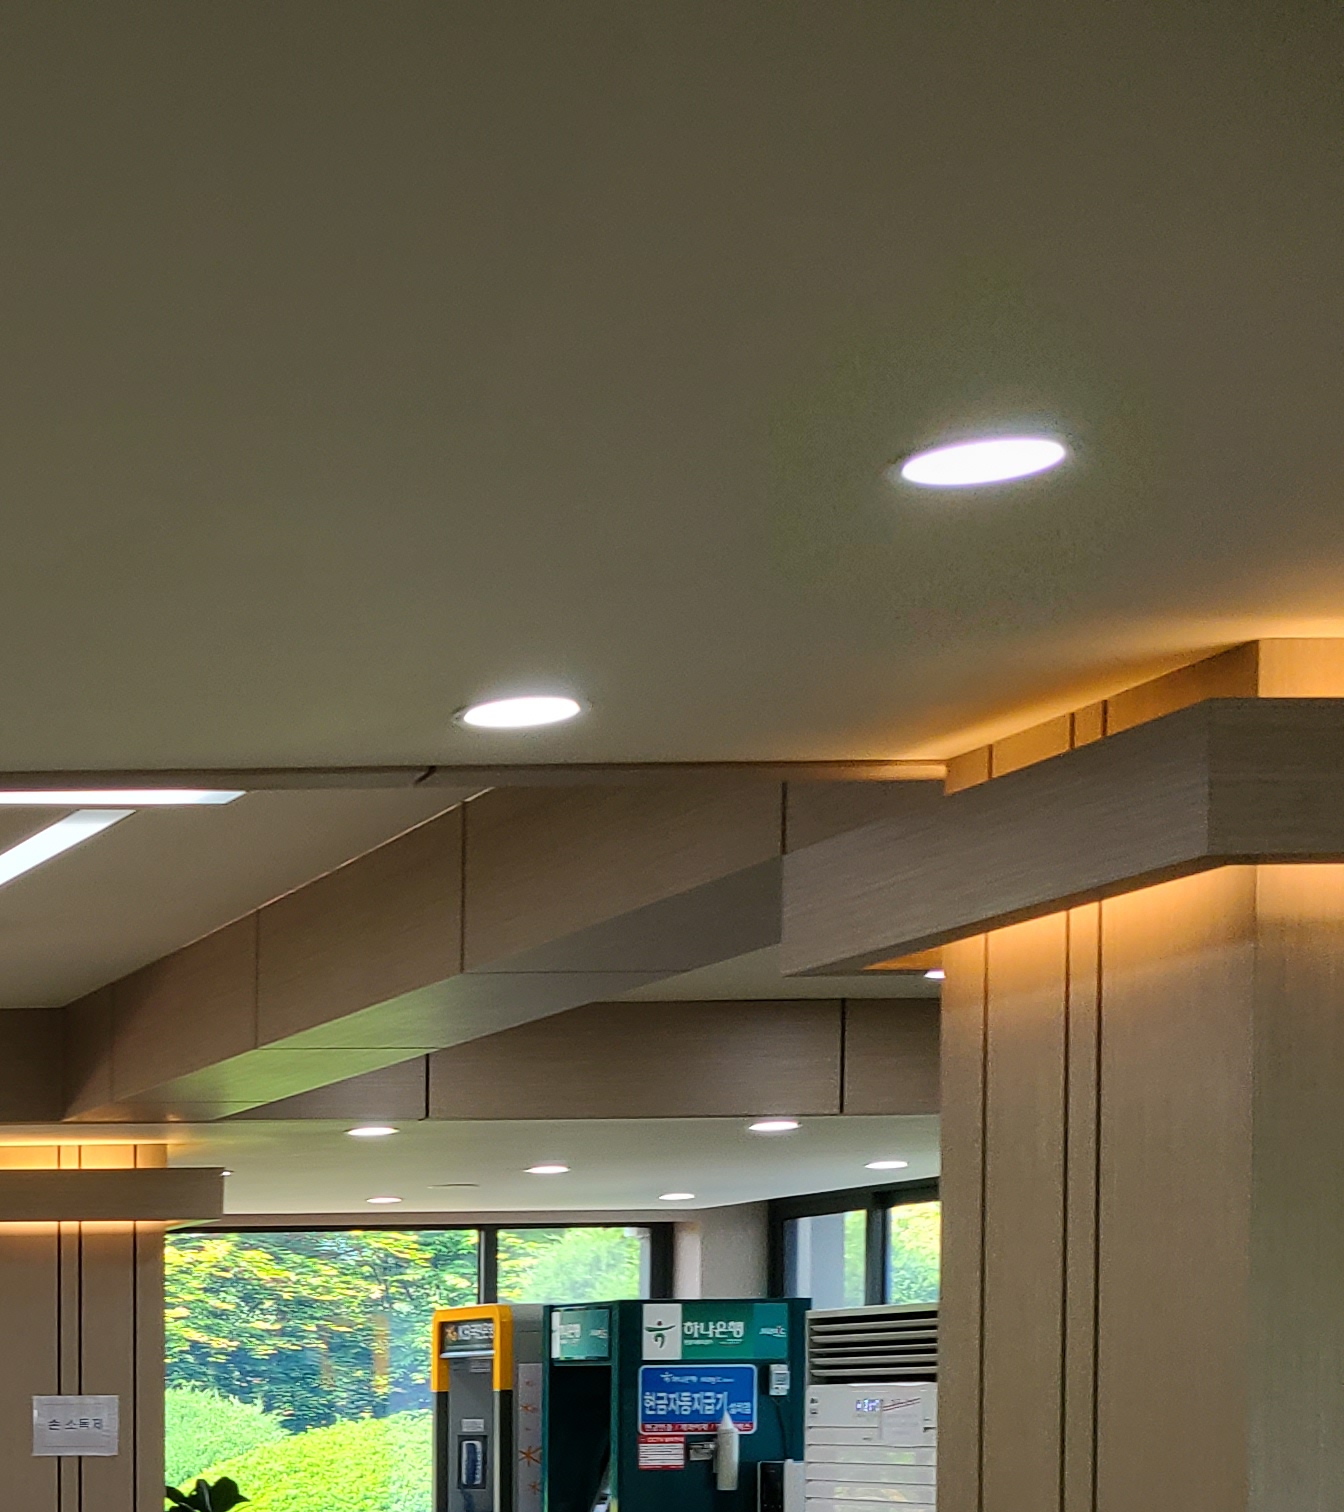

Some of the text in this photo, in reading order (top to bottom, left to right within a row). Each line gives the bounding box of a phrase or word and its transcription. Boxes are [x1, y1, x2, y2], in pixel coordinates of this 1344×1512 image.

[683, 1321, 745, 1338] 하나은행
[644, 1391, 728, 1415] 현금자동지급기
[48, 1418, 103, 1431] 손 소독제
